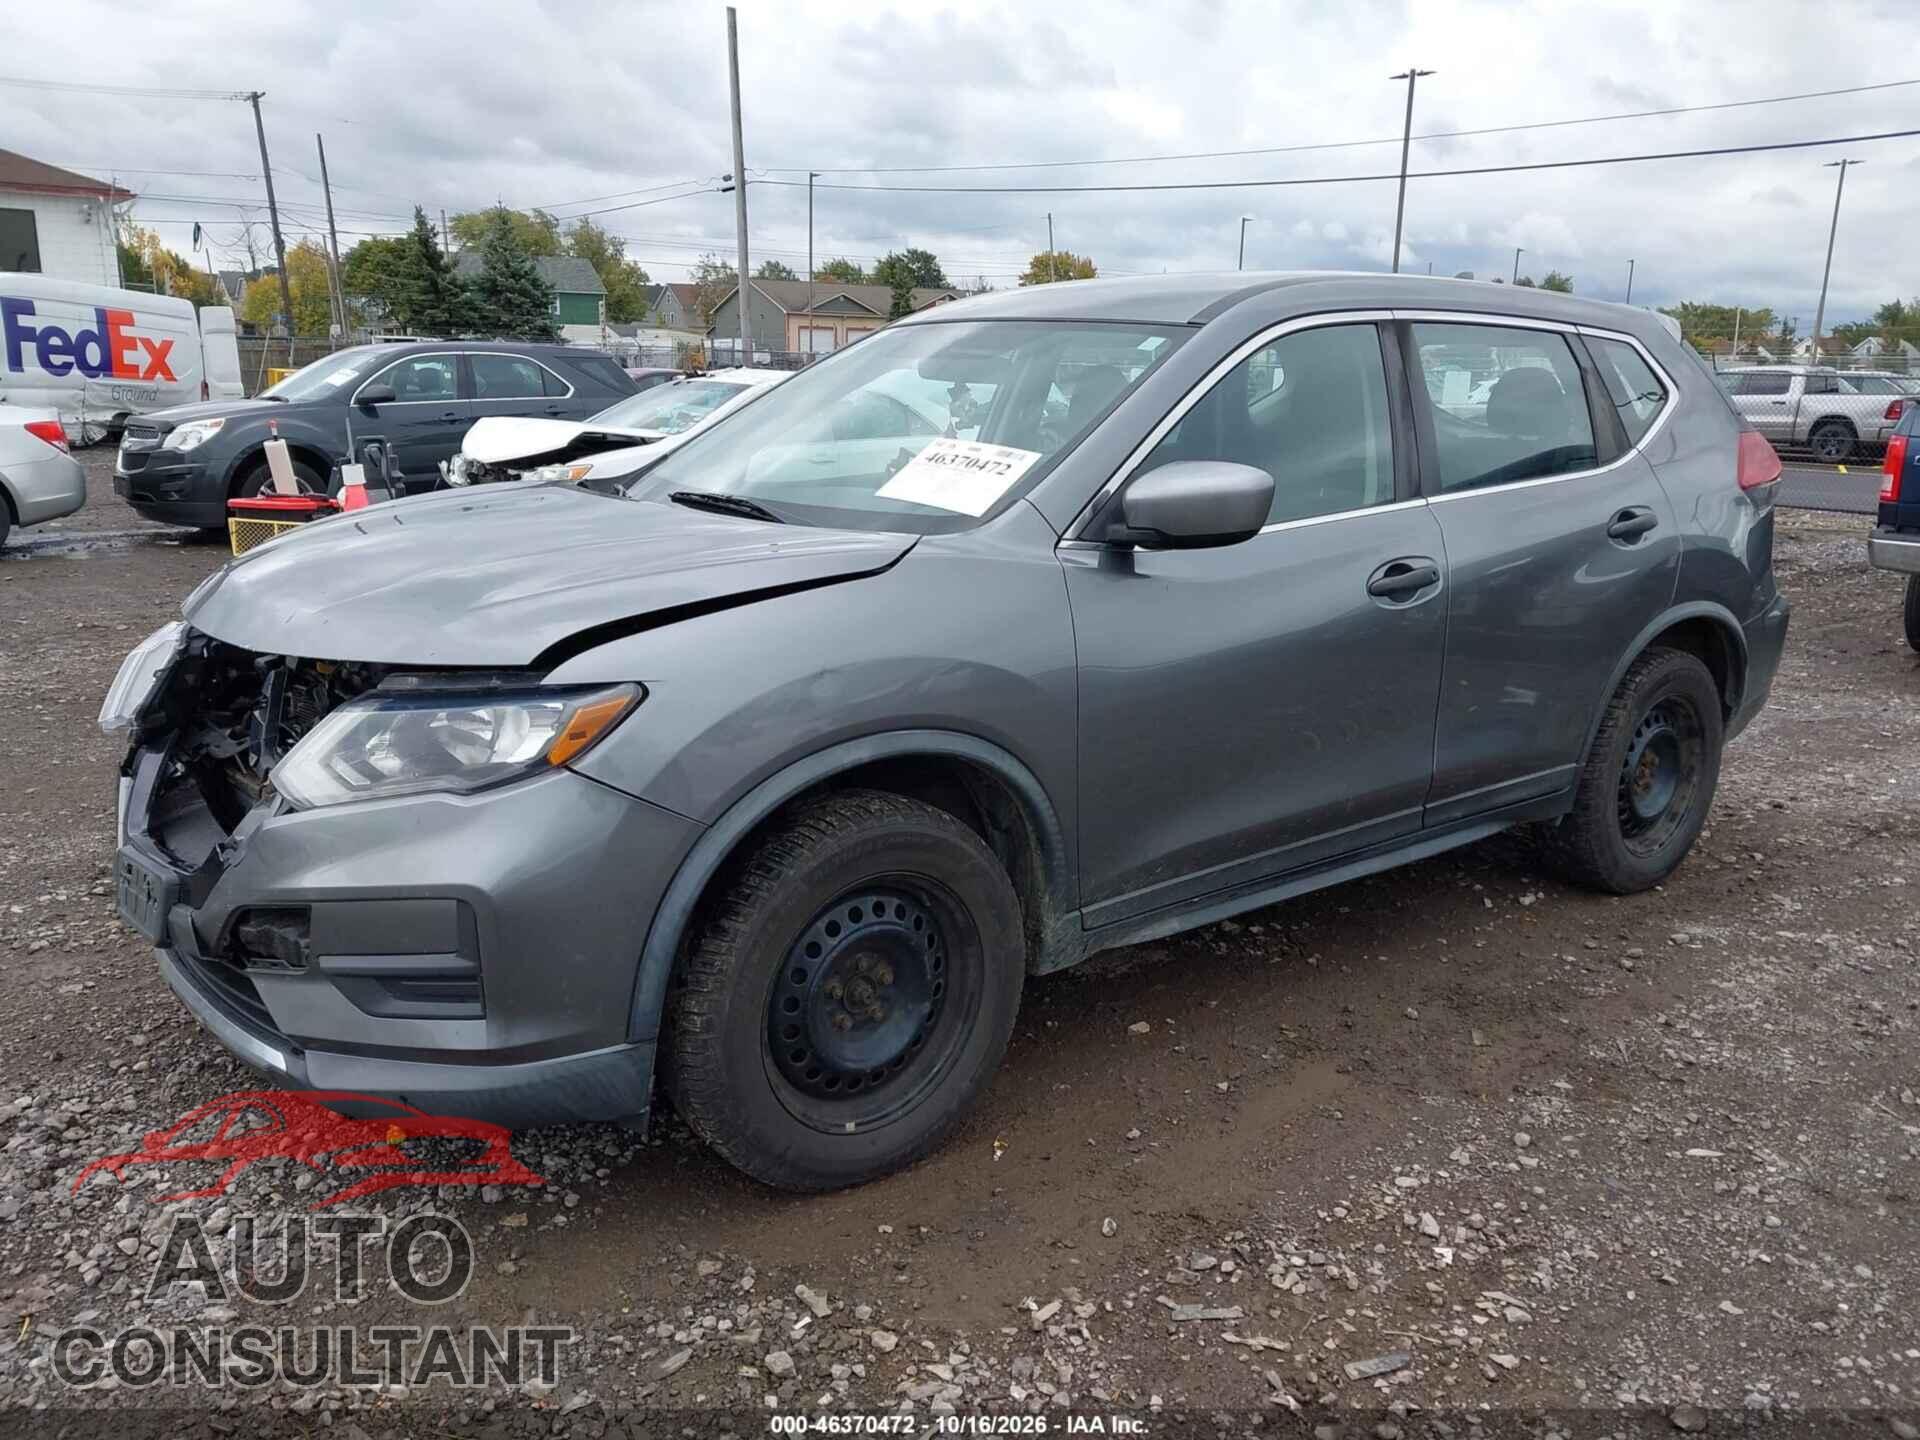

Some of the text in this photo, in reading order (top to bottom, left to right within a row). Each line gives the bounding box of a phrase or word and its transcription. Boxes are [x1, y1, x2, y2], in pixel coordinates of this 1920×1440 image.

[1, 296, 177, 382] FedEx
[111, 385, 158, 401] Ground
[925, 452, 1012, 476] 46370472
